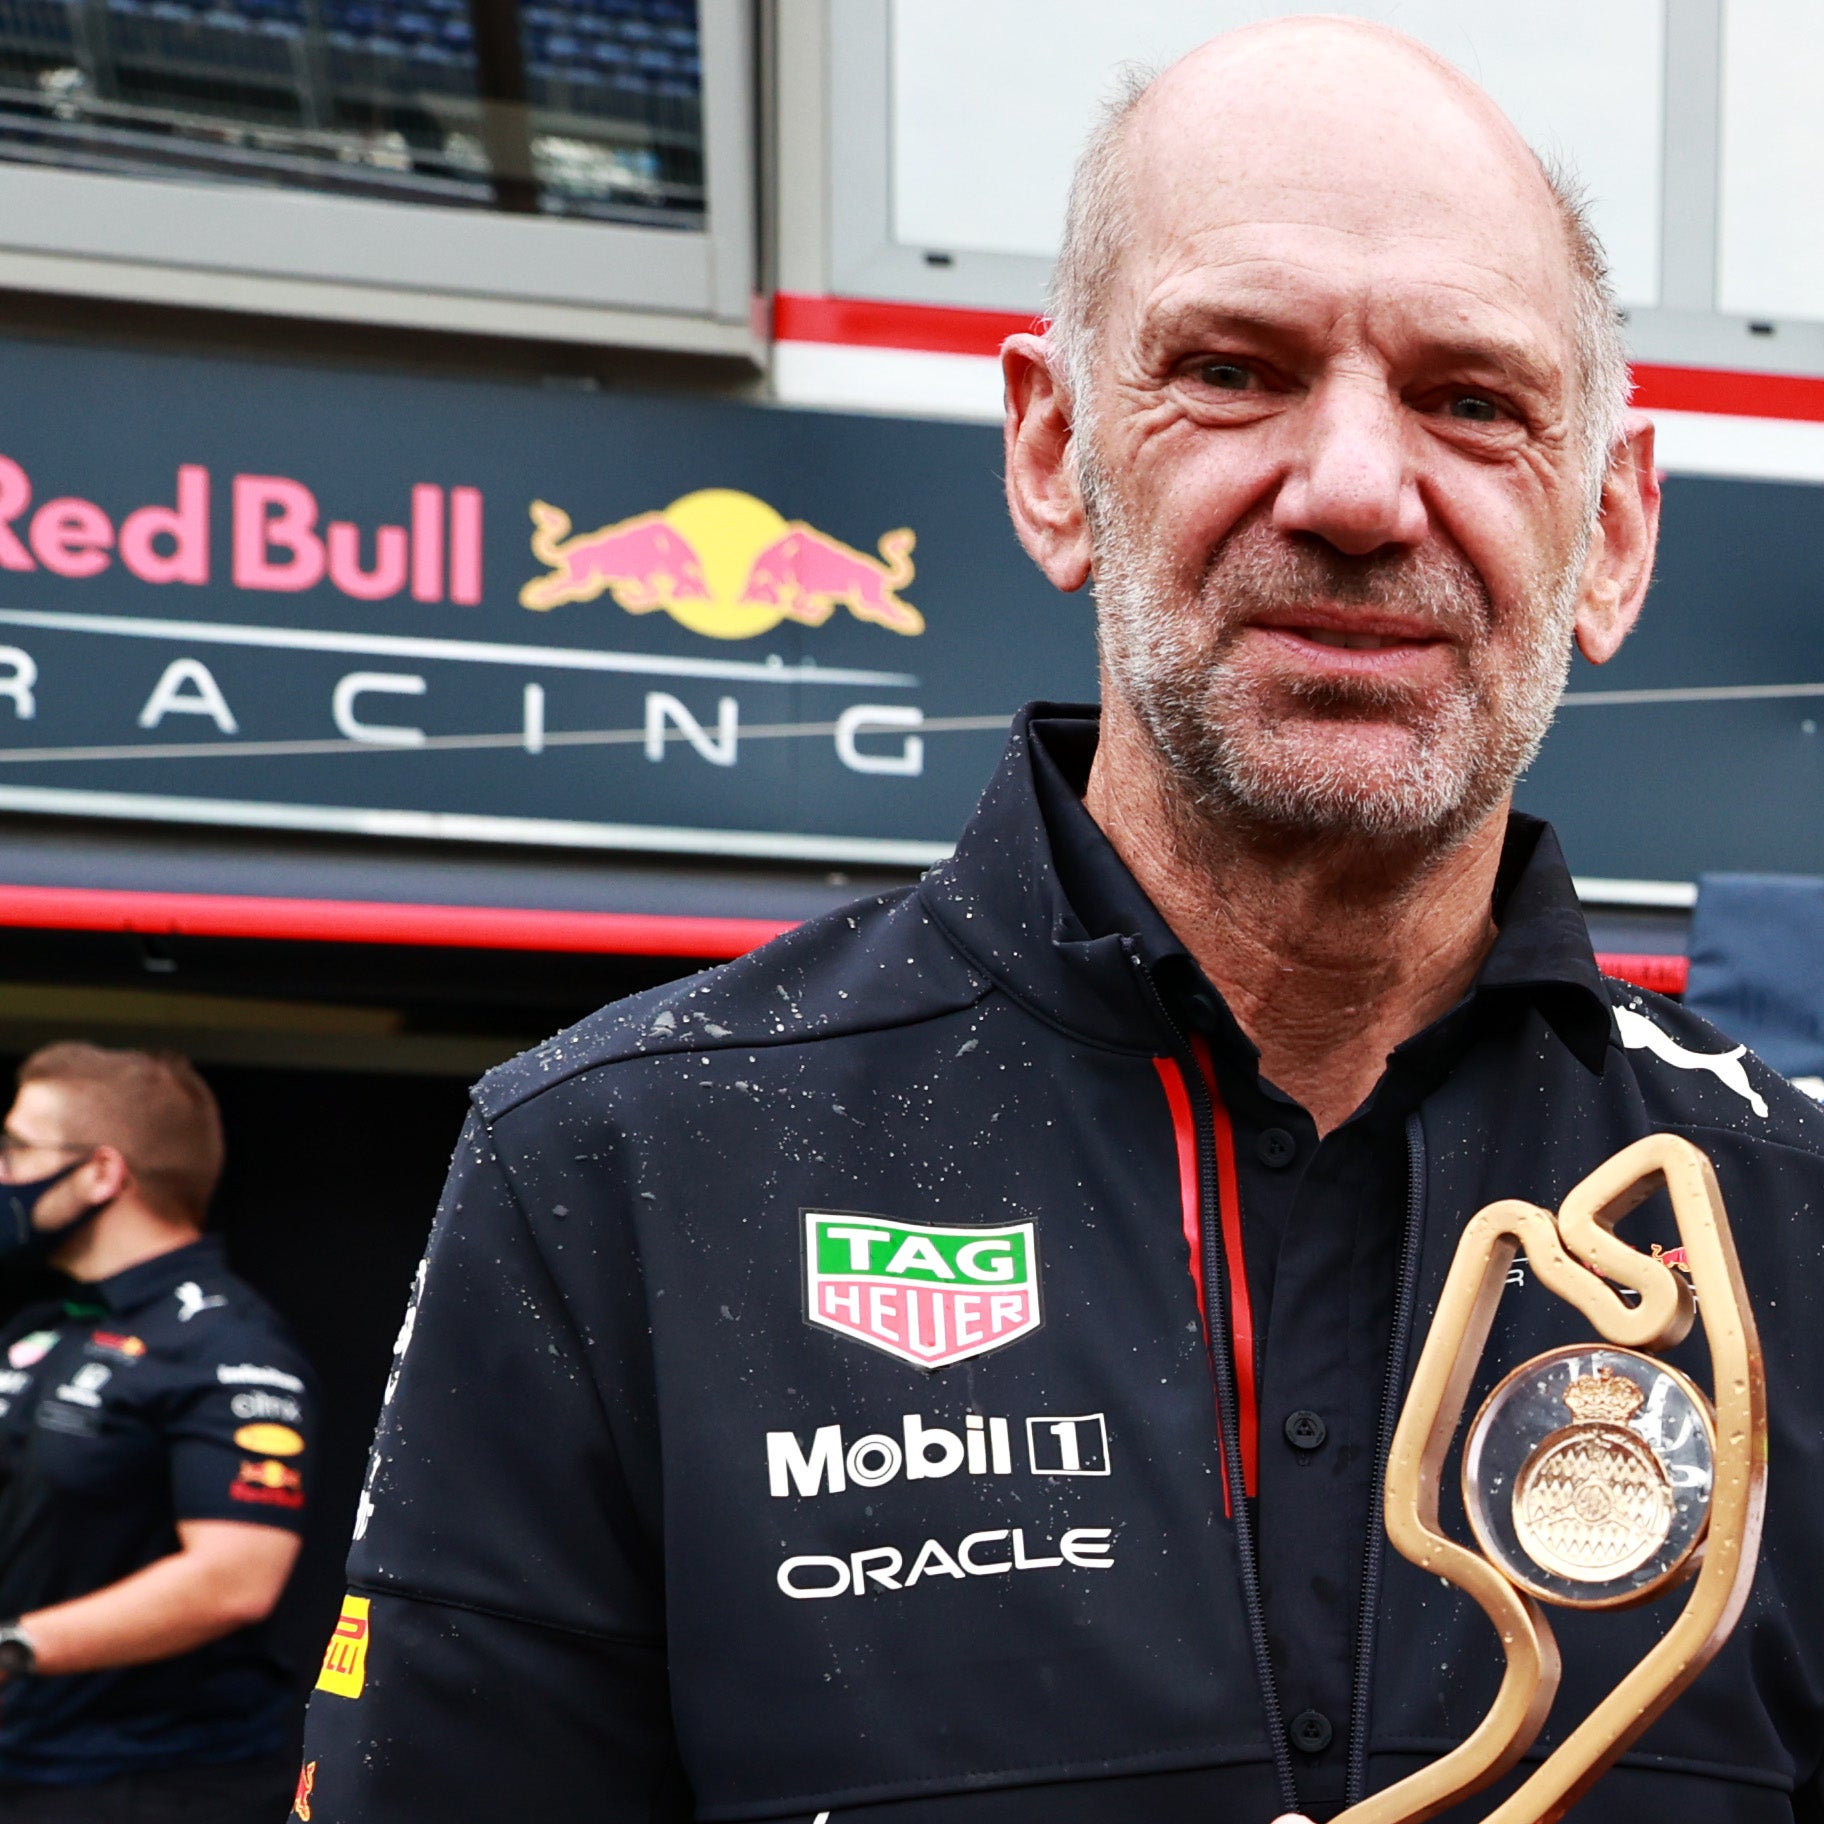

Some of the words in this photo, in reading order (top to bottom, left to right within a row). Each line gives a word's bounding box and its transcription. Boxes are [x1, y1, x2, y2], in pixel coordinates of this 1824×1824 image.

[232, 472, 483, 606] Bull
[826, 1225, 1015, 1282] TAG
[825, 1284, 1028, 1359] HEUER
[766, 1413, 1012, 1497] Mobil
[776, 1527, 1115, 1600] ORACLE
